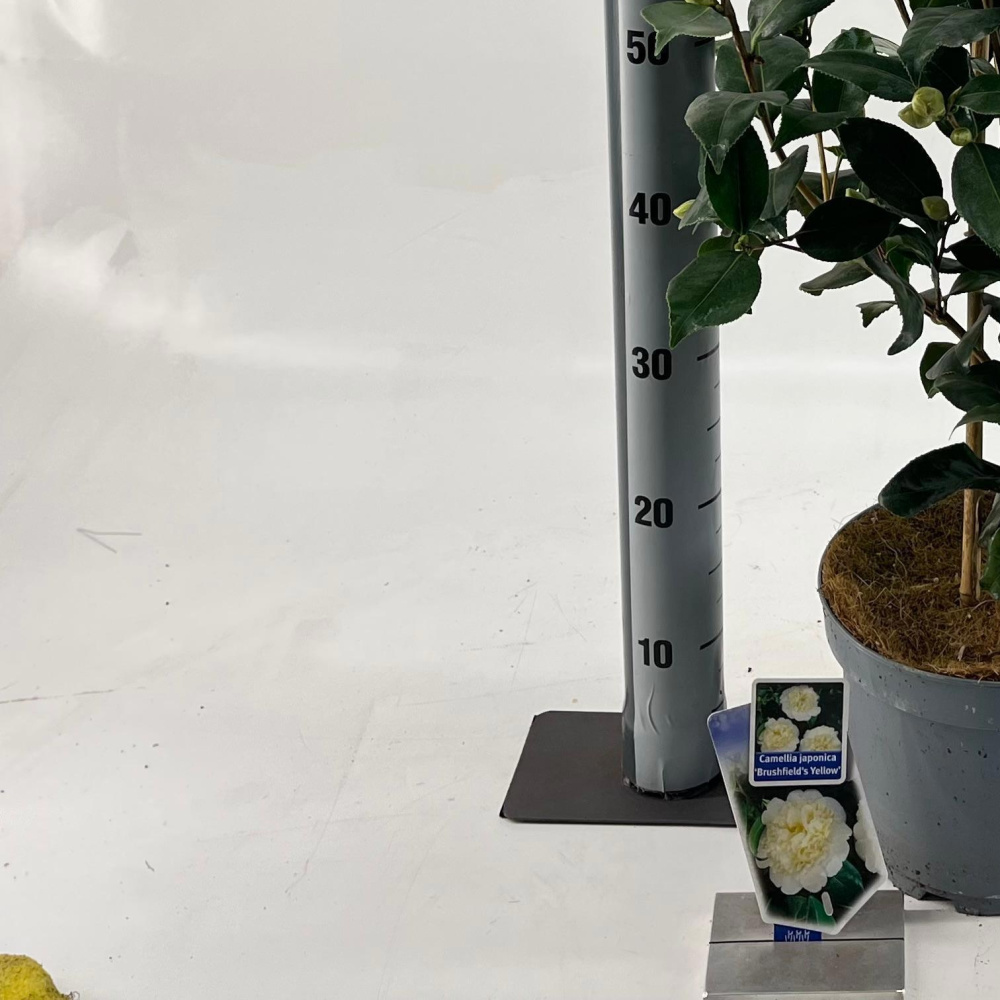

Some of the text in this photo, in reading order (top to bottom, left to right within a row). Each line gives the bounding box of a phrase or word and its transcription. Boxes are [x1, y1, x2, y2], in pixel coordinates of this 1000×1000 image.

[626, 30, 670, 66] 50
[629, 192, 671, 226] 40
[631, 347, 672, 381] 30
[634, 496, 674, 529] 20
[638, 638, 673, 669] 10
[759, 753, 837, 764] Camellia japonica
